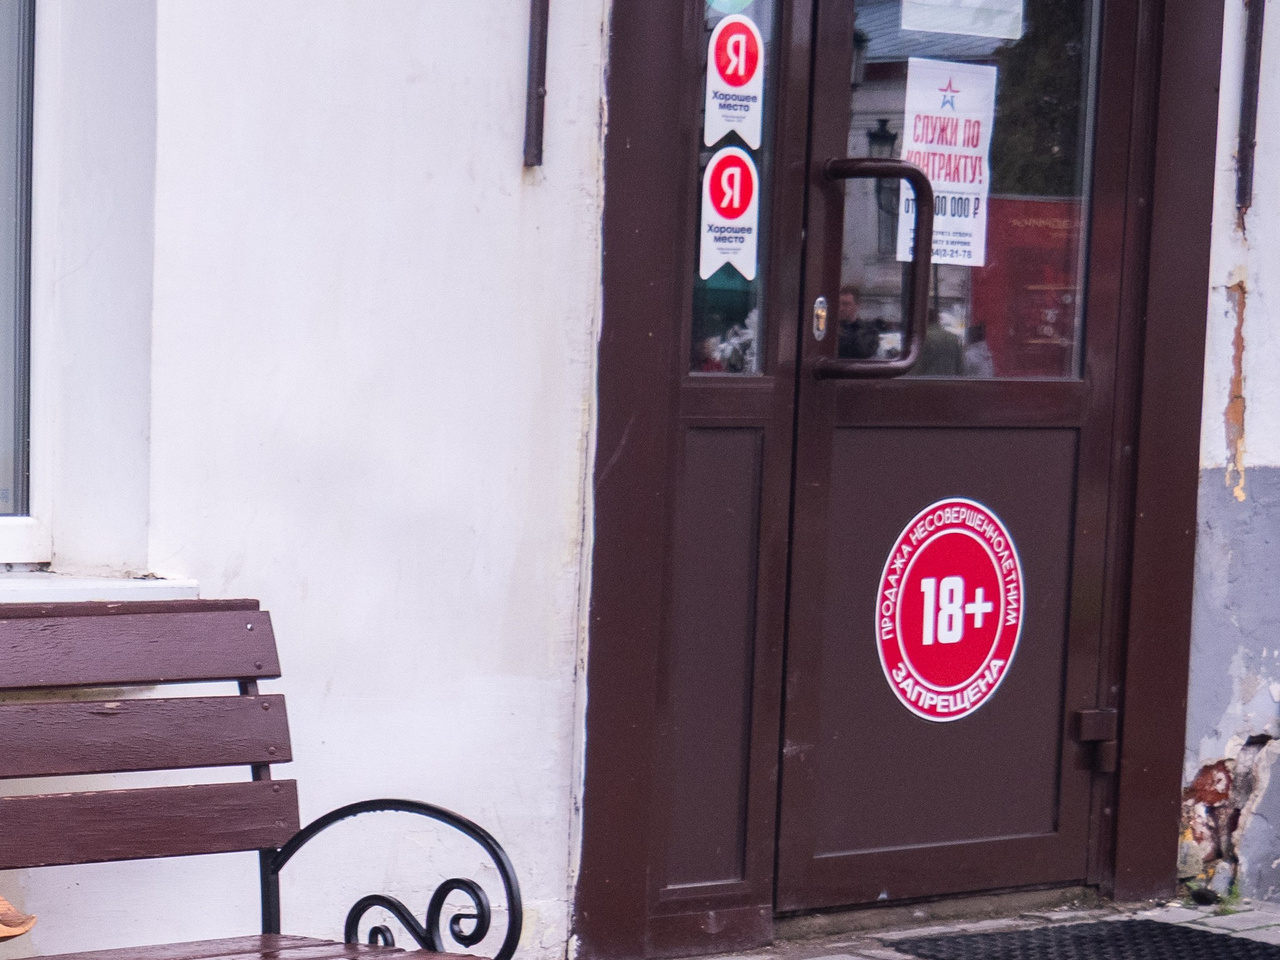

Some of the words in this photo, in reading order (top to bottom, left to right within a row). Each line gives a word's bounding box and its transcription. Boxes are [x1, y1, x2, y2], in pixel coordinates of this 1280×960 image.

[725, 33, 746, 76] Я
[712, 91, 757, 103] Хорошее
[718, 102, 750, 112] место
[913, 114, 959, 147] СЛУЖИ
[963, 119, 981, 148] ПО
[720, 166, 741, 209] Я
[950, 196, 970, 218] 000
[707, 223, 752, 235] Хорошее
[713, 235, 745, 244] место
[881, 544, 912, 640] ПРОДАЖА
[908, 507, 1018, 626] НЕСОВЕРШЕННОЛЕТНИМ
[920, 575, 994, 646] 18+
[892, 658, 1005, 713] ЗАПРЕЩЕНА
